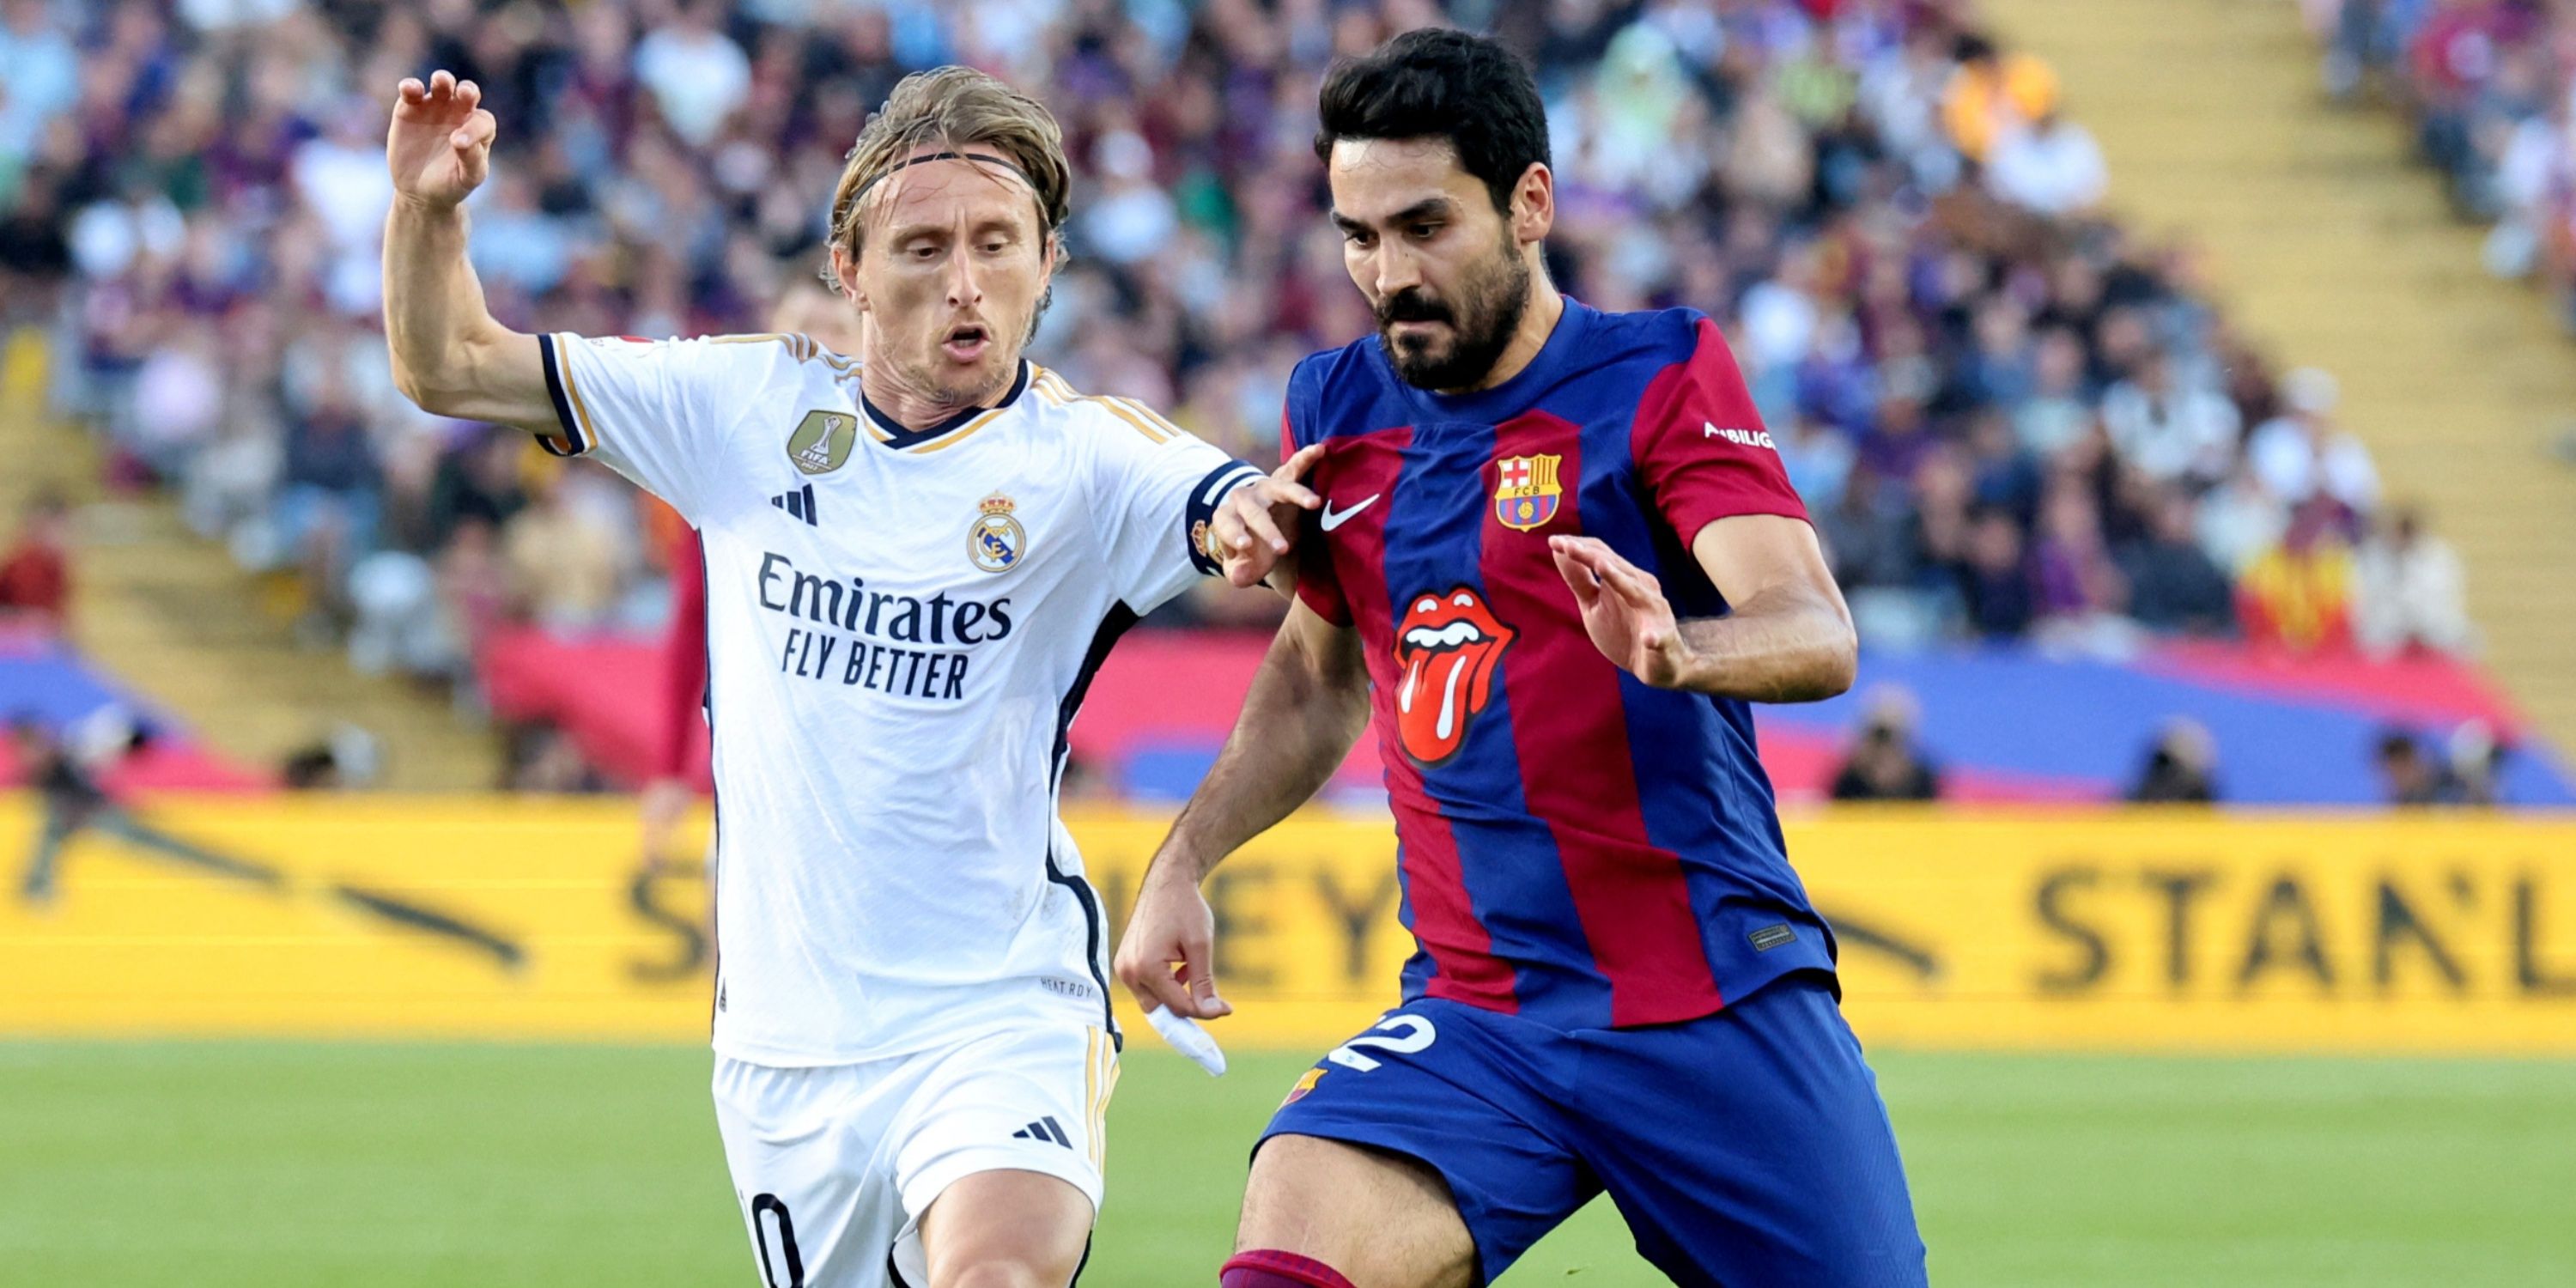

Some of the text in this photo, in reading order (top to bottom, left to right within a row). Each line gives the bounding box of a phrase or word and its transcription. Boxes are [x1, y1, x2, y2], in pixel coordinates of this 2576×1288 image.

[800, 449, 829, 465] FIFA
[758, 551, 1012, 644] Emirates
[782, 629, 969, 700] FLY BETTER
[1328, 1014, 1436, 1072] 2
